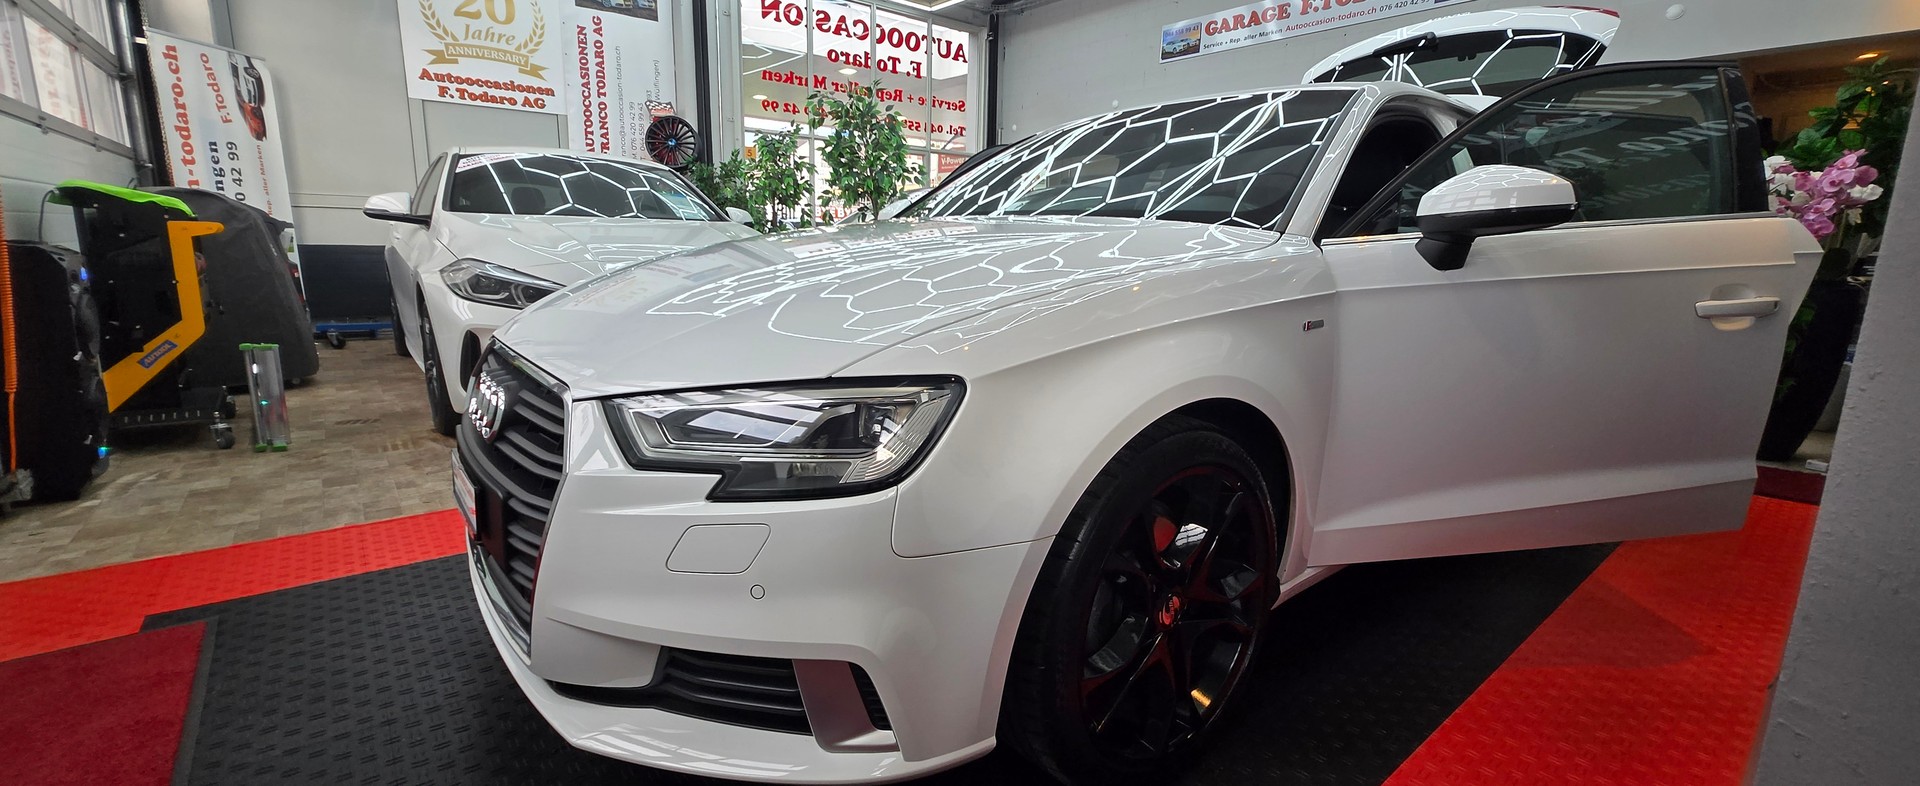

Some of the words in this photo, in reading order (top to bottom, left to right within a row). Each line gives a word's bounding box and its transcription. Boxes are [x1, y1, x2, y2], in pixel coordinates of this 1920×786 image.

[592, 15, 603, 38] AG
[1203, 42, 1223, 50] Service
[1243, 33, 1257, 41] aller
[1258, 28, 1283, 38] Marken
[1285, 7, 1377, 33] Autooccasion-todaro.ch
[1379, 4, 1393, 13] 076
[1394, 0, 1408, 9] 420
[1204, 3, 1291, 37] GARAGE
[463, 24, 516, 45] Jahre
[447, 45, 527, 66] ANNIVERSARY
[593, 39, 607, 99] TODARO
[418, 68, 556, 97] Autooccasionen
[437, 85, 454, 99] F.
[455, 87, 518, 106] Todaro
[521, 96, 547, 110] AG
[615, 45, 627, 157] ranco@autooccasion-todaro.ch
[629, 101, 635, 111] 99
[162, 44, 200, 189] n-todaro.ch
[226, 141, 240, 162] 99
[257, 144, 267, 176] Marken
[208, 140, 226, 192] ngen
[230, 167, 244, 188] 42
[261, 176, 270, 196] aller
